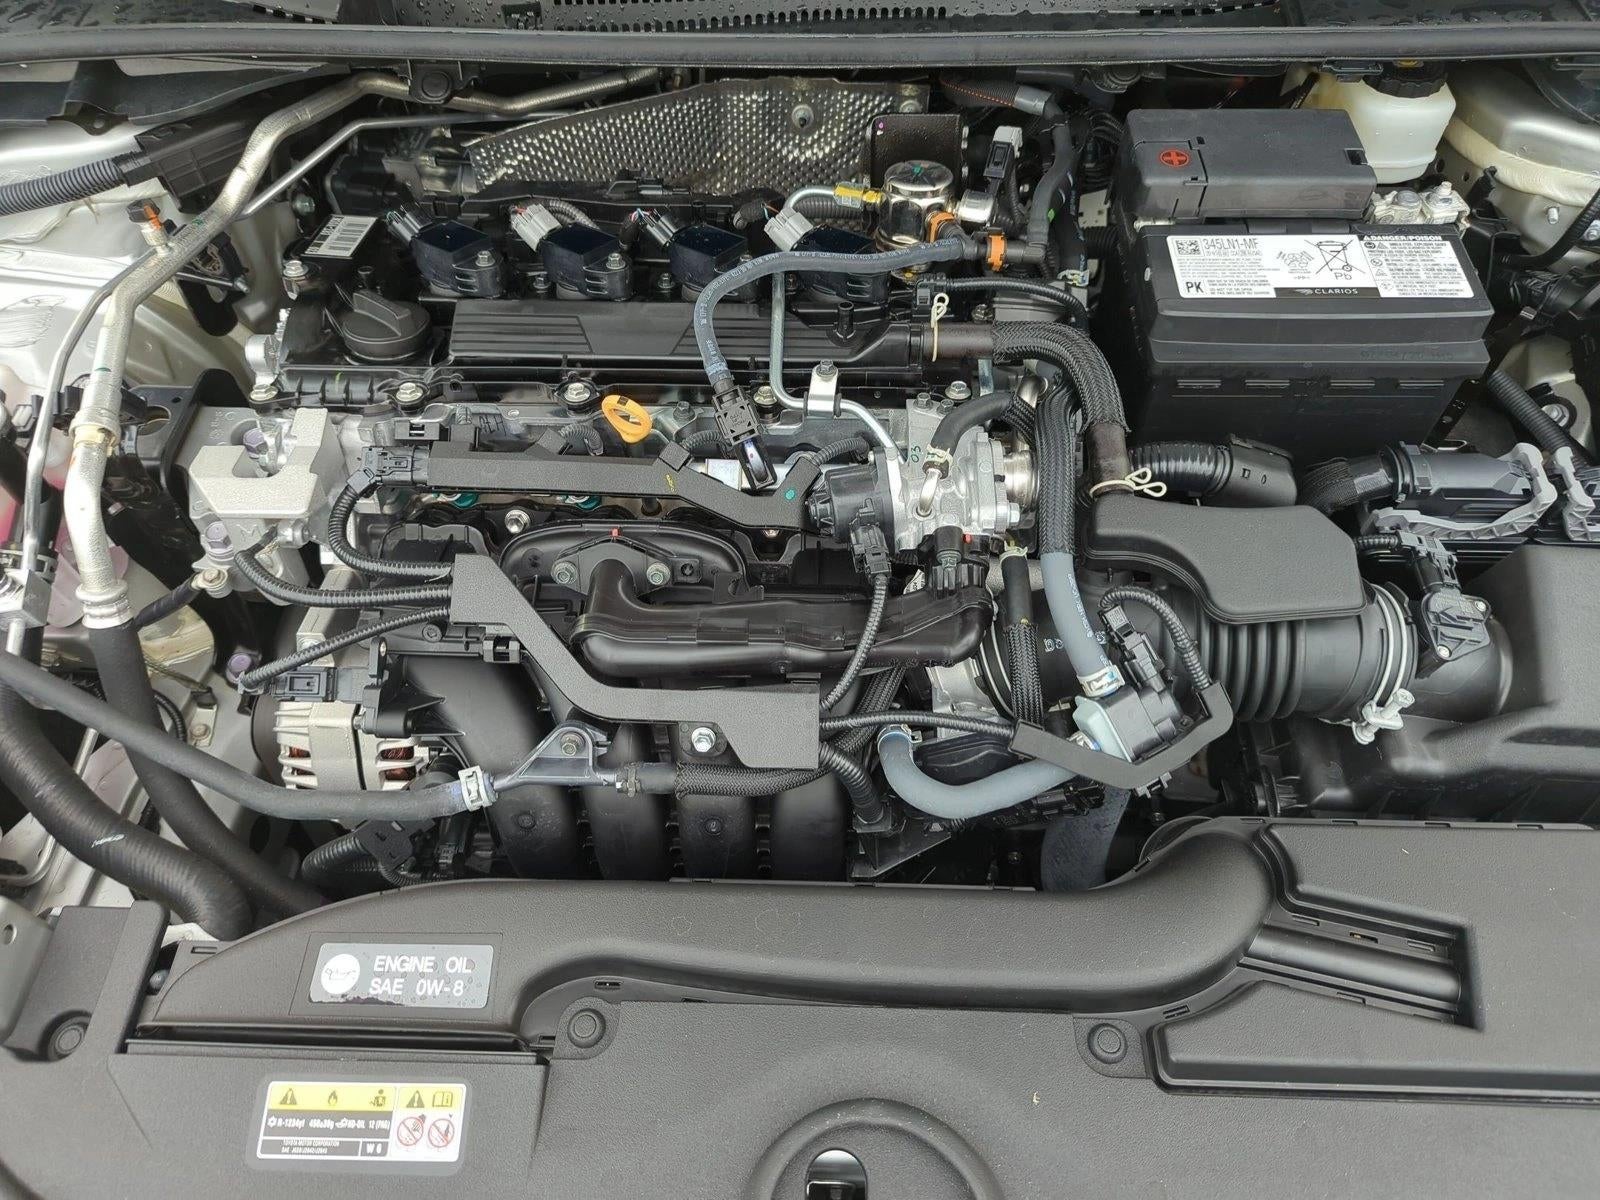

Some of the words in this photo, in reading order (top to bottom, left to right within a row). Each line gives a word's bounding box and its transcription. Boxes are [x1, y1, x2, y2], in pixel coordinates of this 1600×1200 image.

[1202, 238, 1259, 250] 345LN1-MF
[1335, 272, 1352, 280] Pb
[1185, 281, 1204, 293] PK
[373, 955, 435, 972] ENGINE
[446, 956, 472, 973] OIL
[368, 978, 405, 995] SAE
[416, 979, 464, 996] 0W-8
[366, 1143, 375, 1154] W
